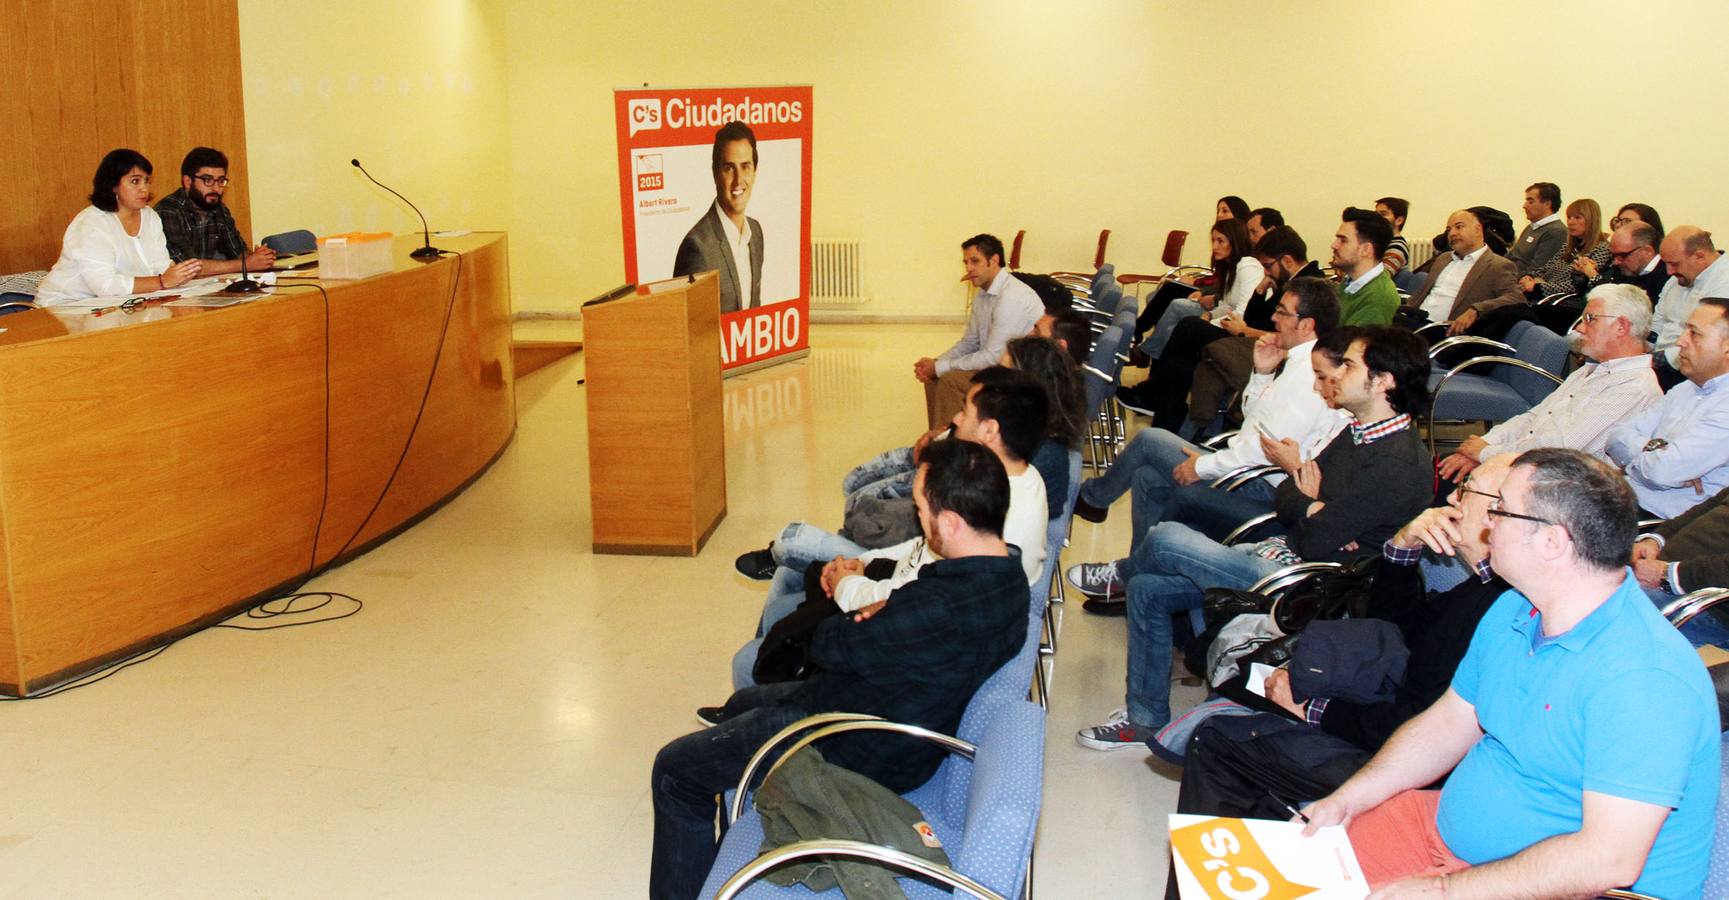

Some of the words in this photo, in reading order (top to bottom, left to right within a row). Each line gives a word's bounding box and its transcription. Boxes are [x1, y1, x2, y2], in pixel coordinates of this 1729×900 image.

[633, 105, 658, 124] C's
[666, 97, 802, 128] Ciudadanos
[640, 176, 661, 188] 2015
[639, 199, 658, 208] Albert
[658, 198, 678, 206] Rivera
[1200, 827, 1270, 900] C's
